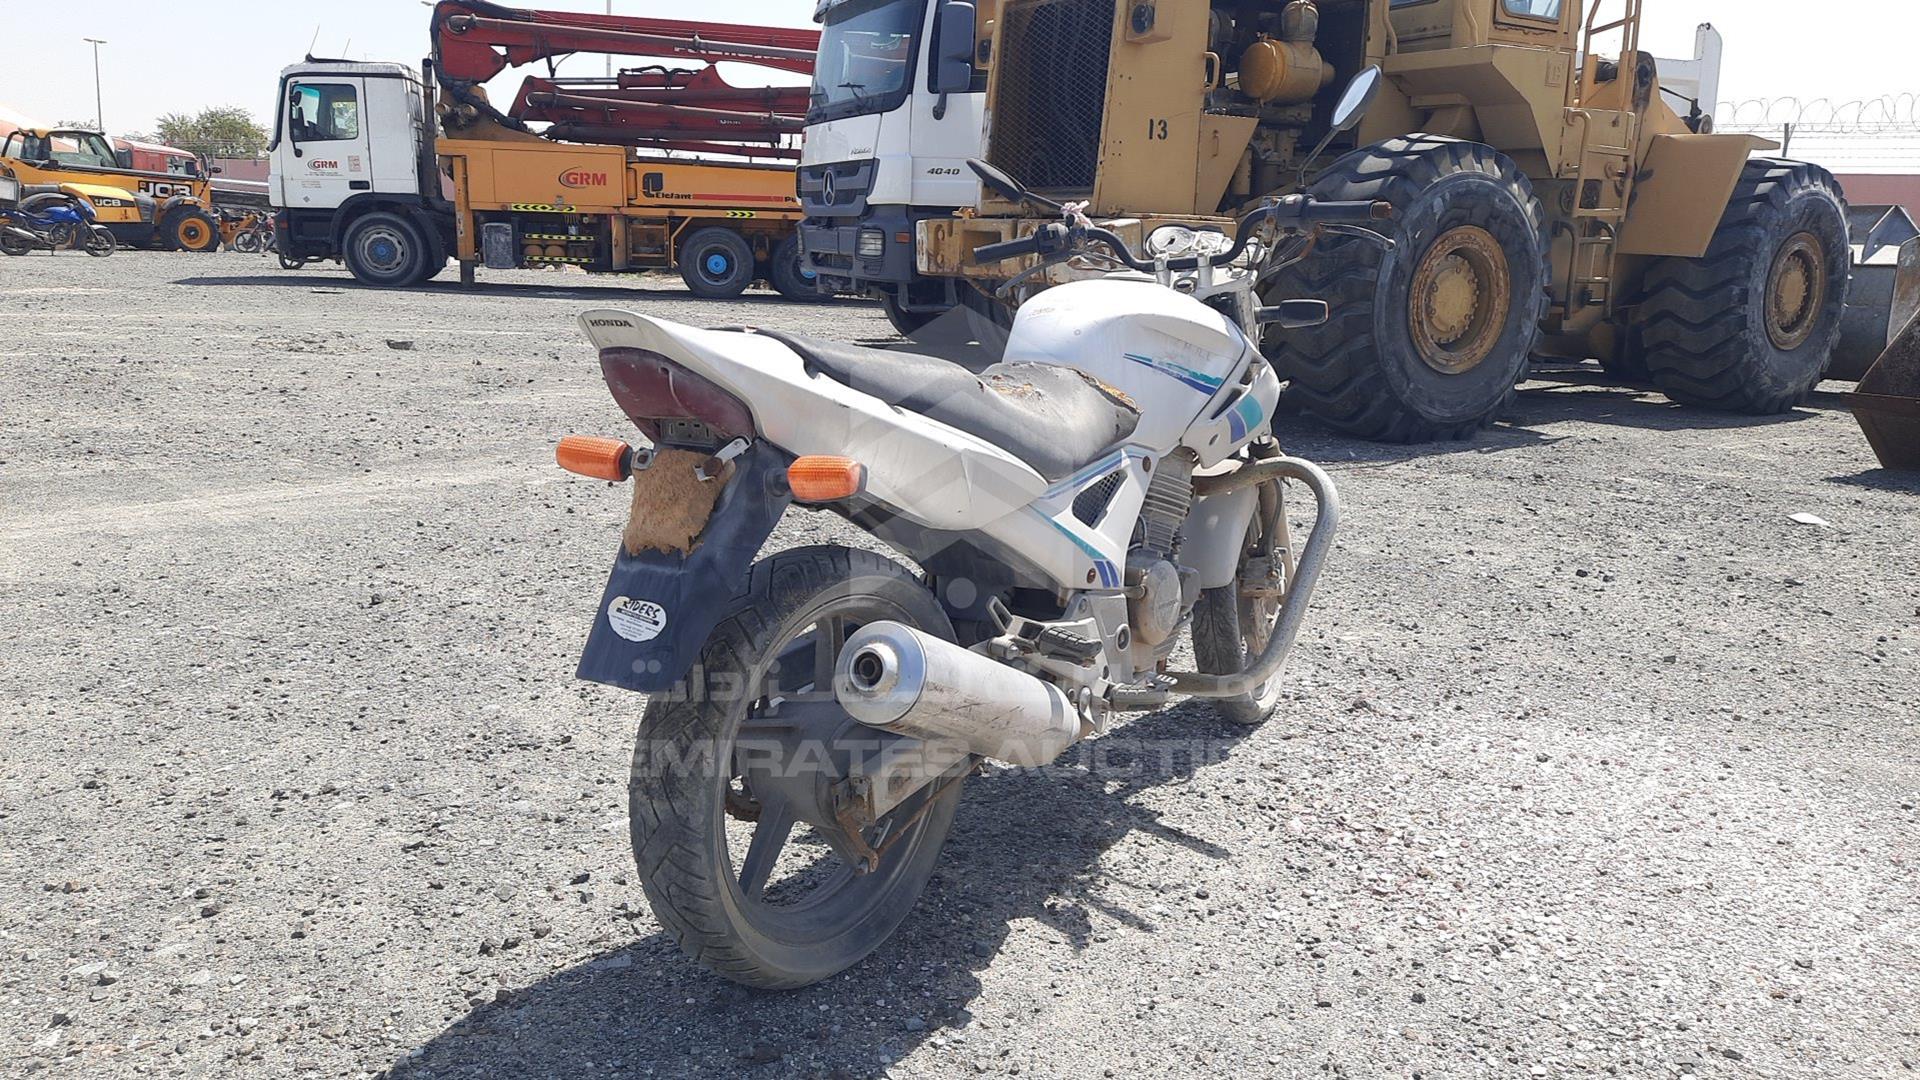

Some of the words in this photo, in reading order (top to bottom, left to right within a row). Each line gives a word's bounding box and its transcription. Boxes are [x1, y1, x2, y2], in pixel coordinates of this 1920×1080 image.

[1148, 118, 1168, 140] 13
[312, 160, 338, 169] GRM
[927, 167, 960, 175] 4040
[565, 172, 607, 186] GRM
[140, 182, 192, 198] JCB
[94, 198, 122, 207] JCB
[590, 319, 634, 327] HONDA
